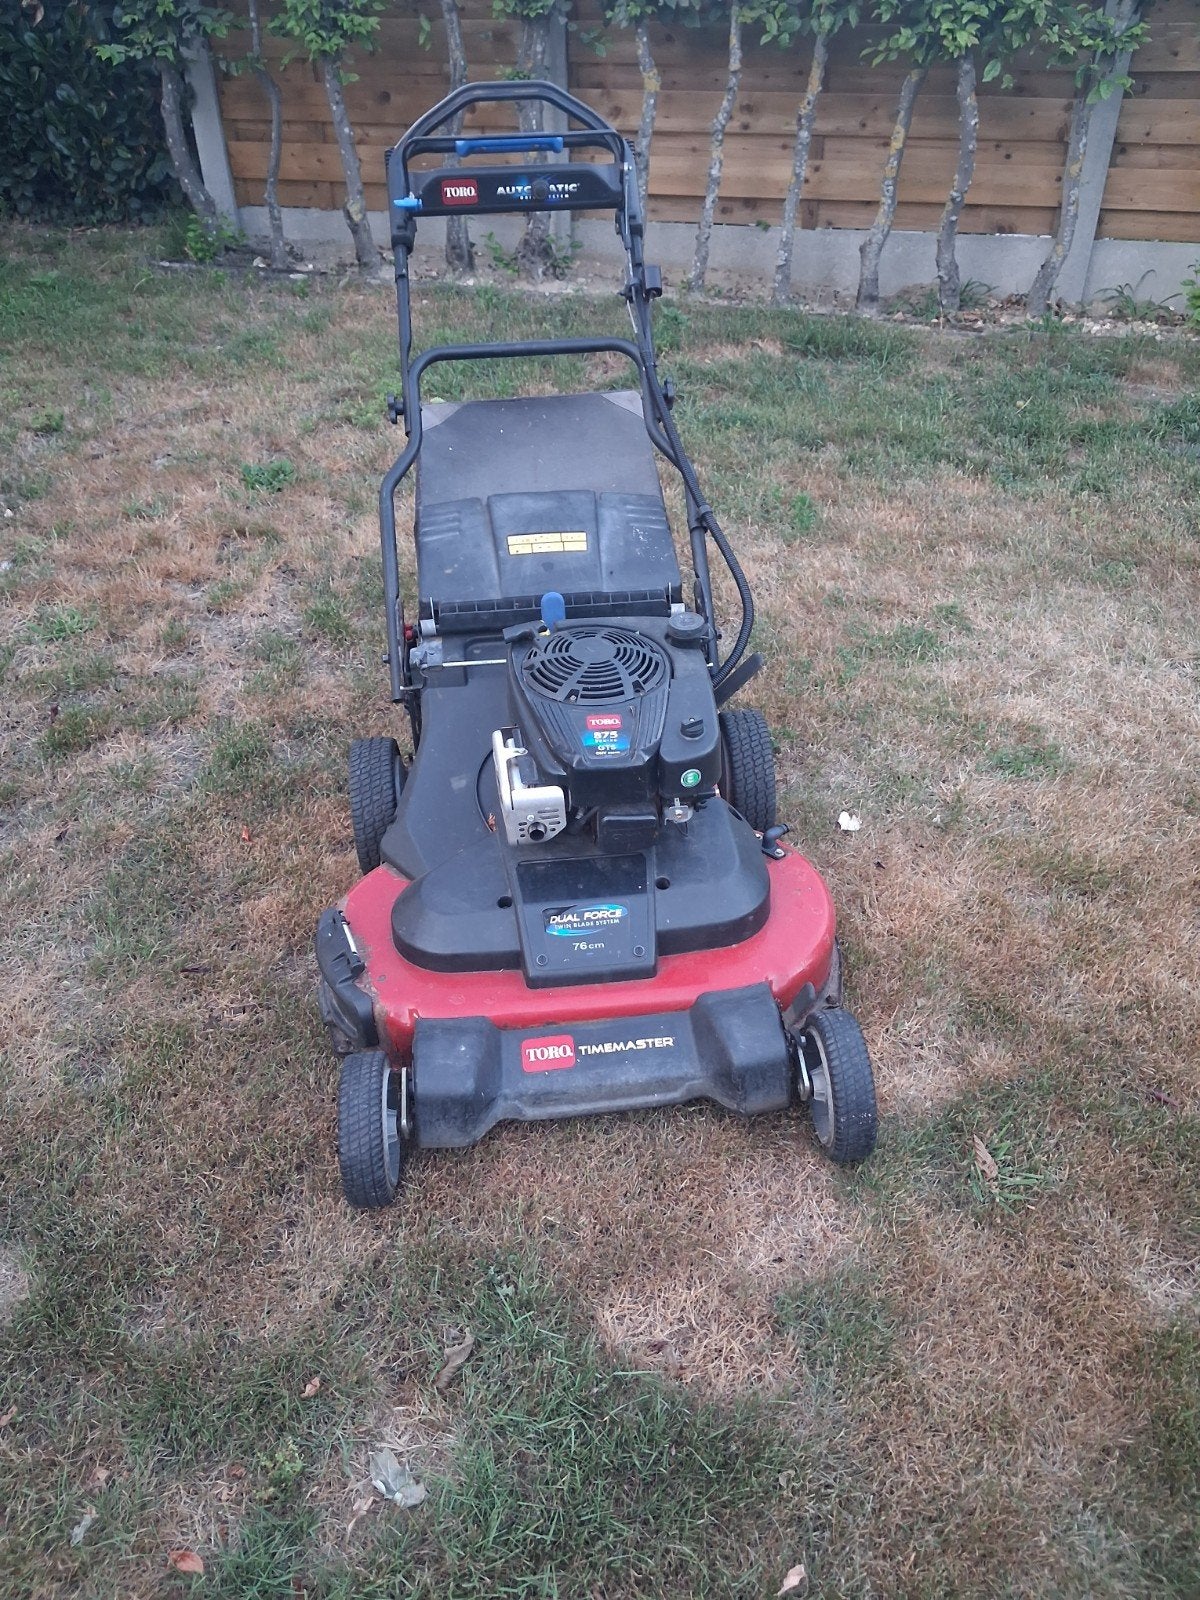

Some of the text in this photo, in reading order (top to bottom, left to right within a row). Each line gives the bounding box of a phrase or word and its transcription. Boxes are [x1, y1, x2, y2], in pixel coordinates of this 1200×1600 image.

[444, 187, 476, 197] TORO
[496, 183, 578, 195] AUTOATIC
[590, 718, 620, 726] TORO
[593, 730, 618, 739] 875
[549, 908, 623, 924] DUAL FORCE
[573, 921, 594, 929] BLADE
[595, 918, 620, 926] SYSTEM
[525, 1037, 675, 1062] TORO TIMEMASTER
